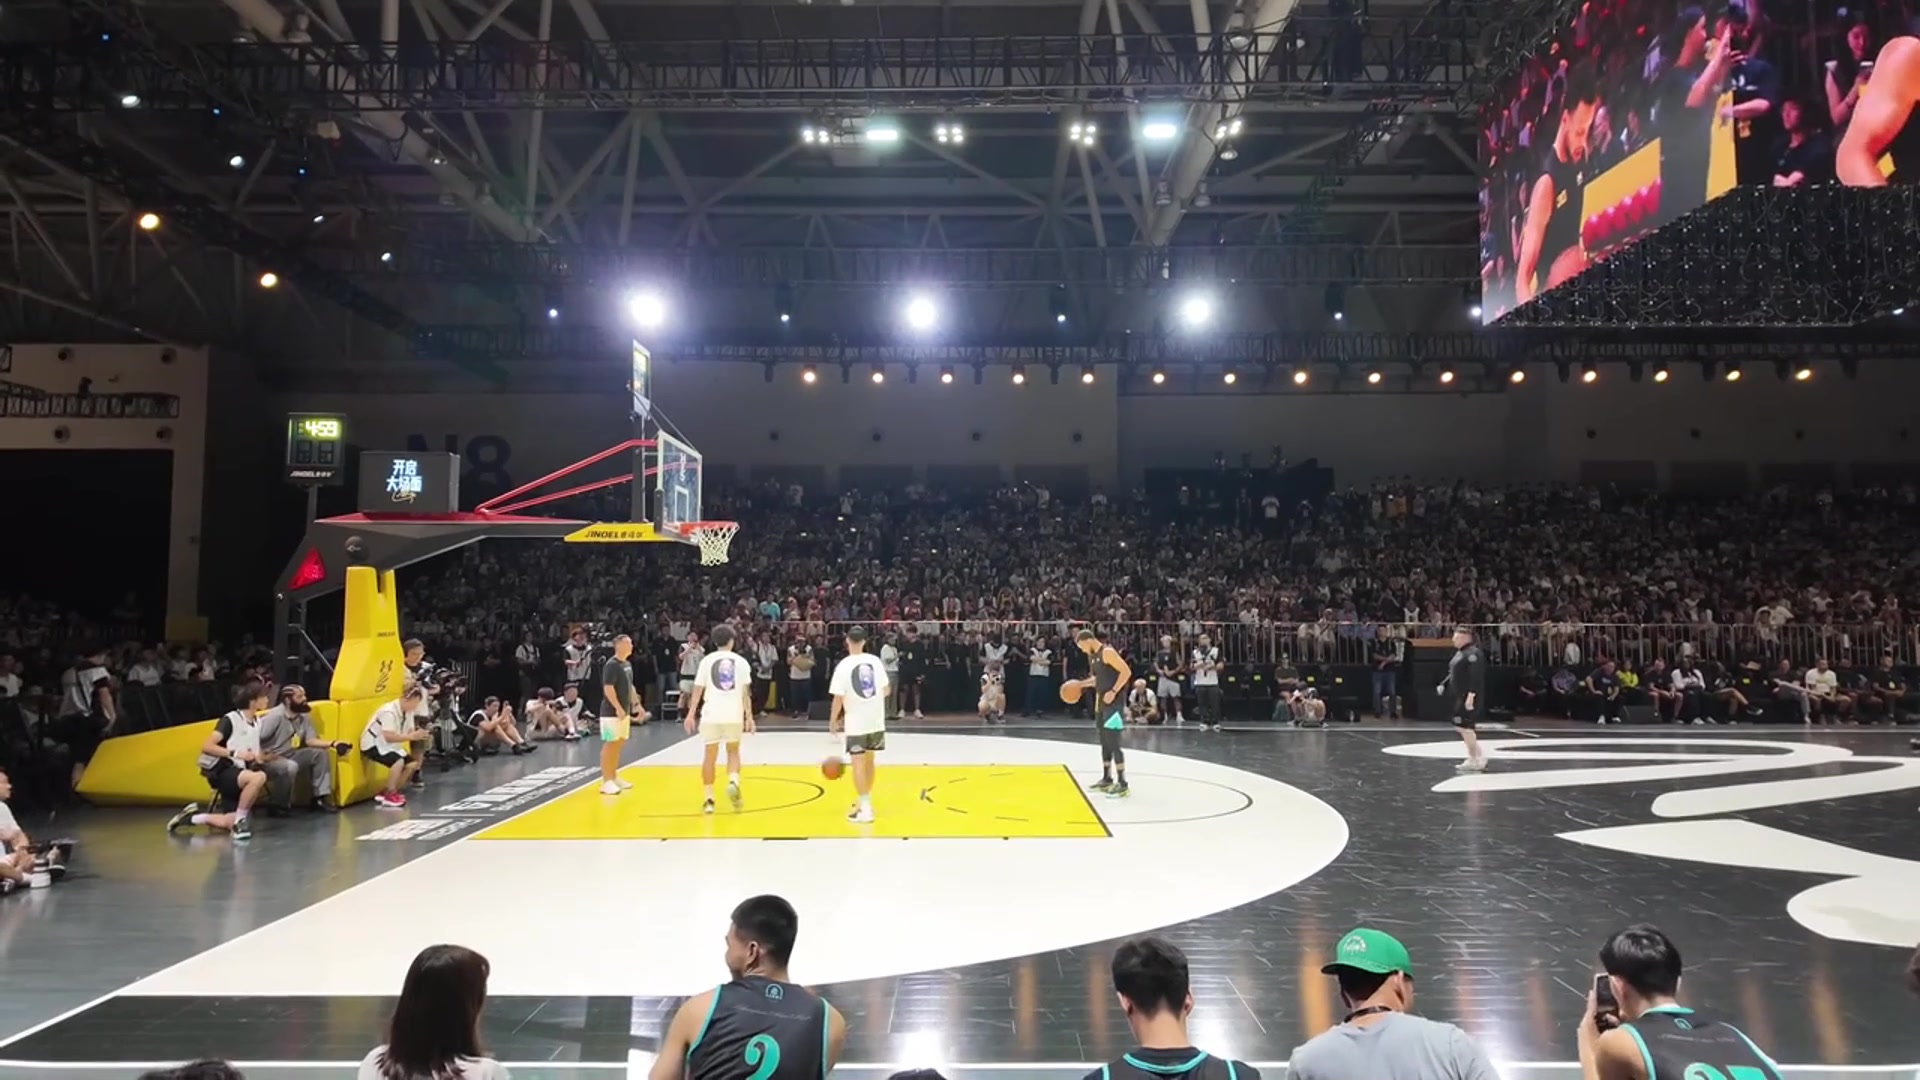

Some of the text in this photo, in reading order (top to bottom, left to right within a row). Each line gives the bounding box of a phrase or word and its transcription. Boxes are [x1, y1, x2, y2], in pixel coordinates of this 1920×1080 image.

[393, 459, 417, 475] 开启
[386, 475, 422, 492] 大场面
